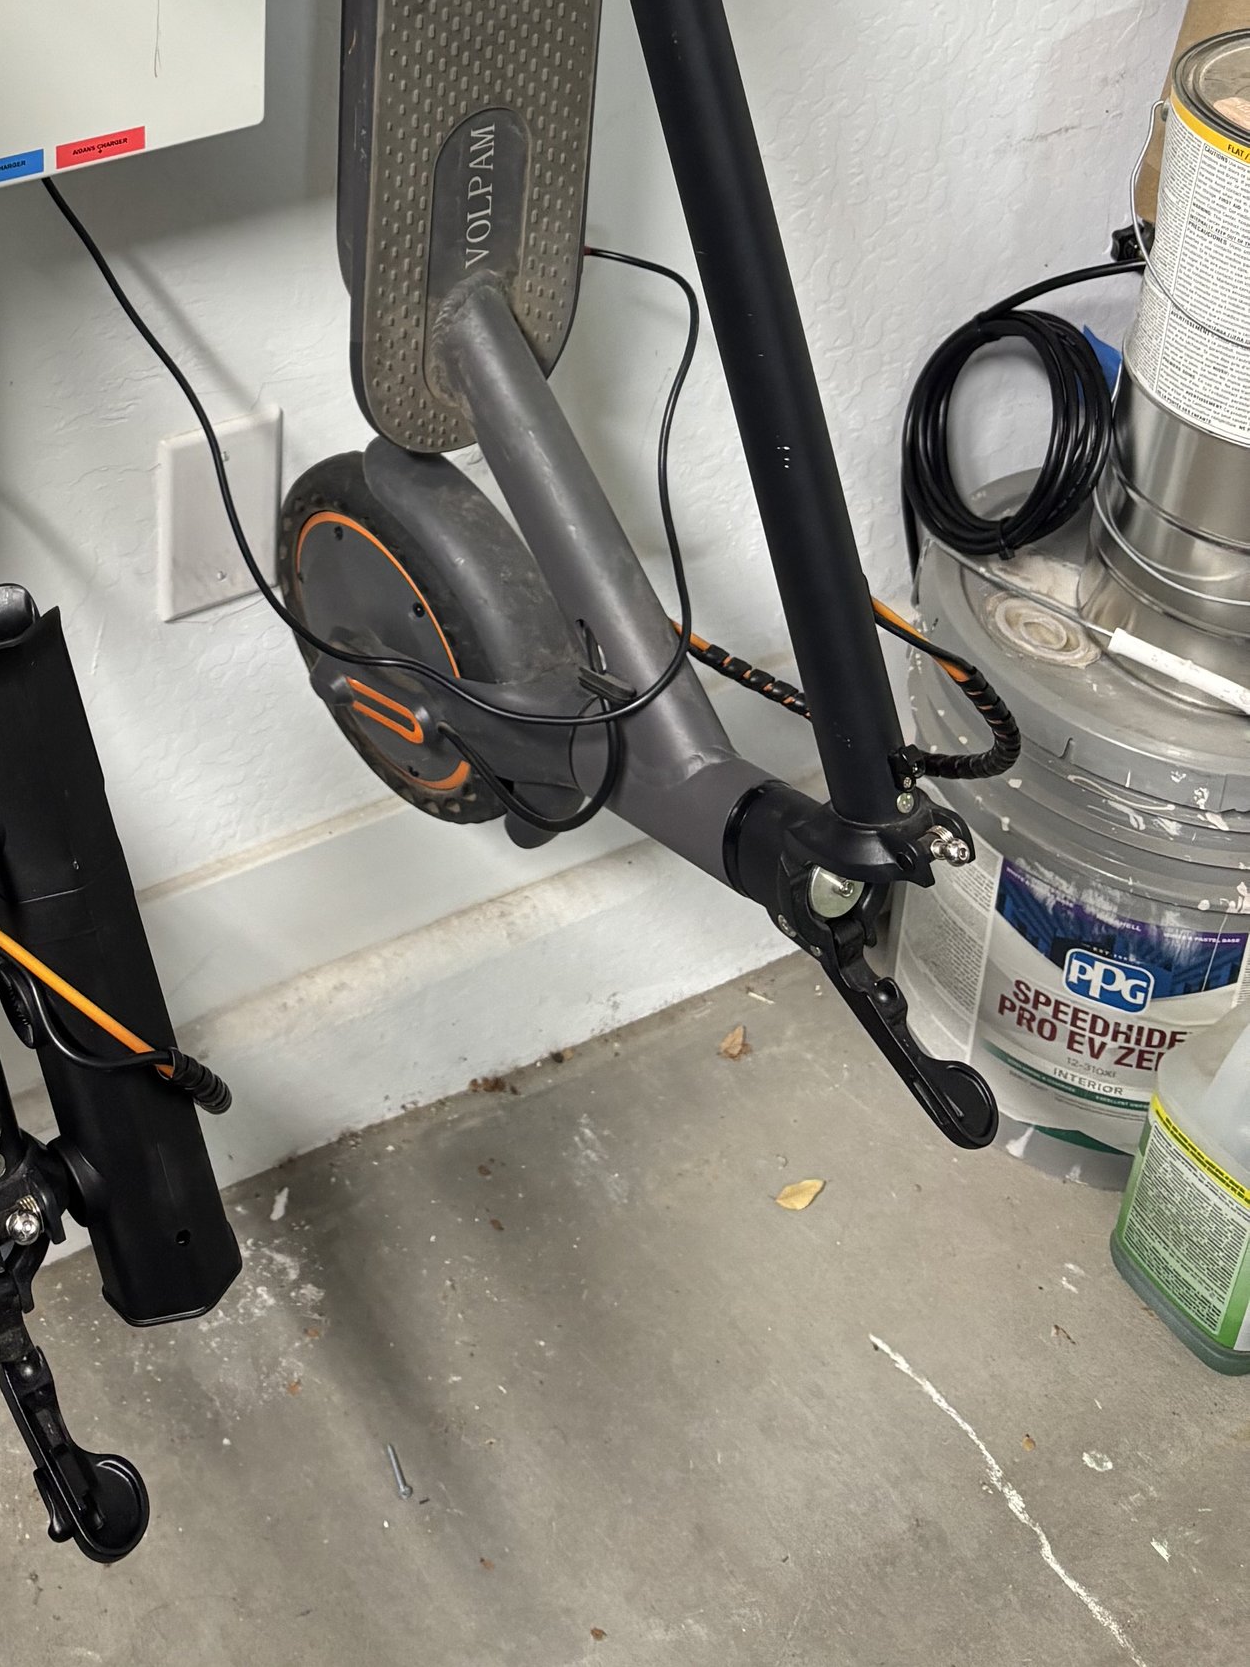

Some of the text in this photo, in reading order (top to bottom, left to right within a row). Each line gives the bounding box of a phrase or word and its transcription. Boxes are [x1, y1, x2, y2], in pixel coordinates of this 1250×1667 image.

[96, 137, 128, 150] CHARGER
[1227, 143, 1244, 157] FLAT
[465, 123, 496, 269] VOLPAM
[1068, 959, 1148, 1005] PPG
[997, 993, 1058, 1042] PRO
[1066, 1029, 1108, 1060] EV
[1053, 1067, 1124, 1096] INTERIOR
